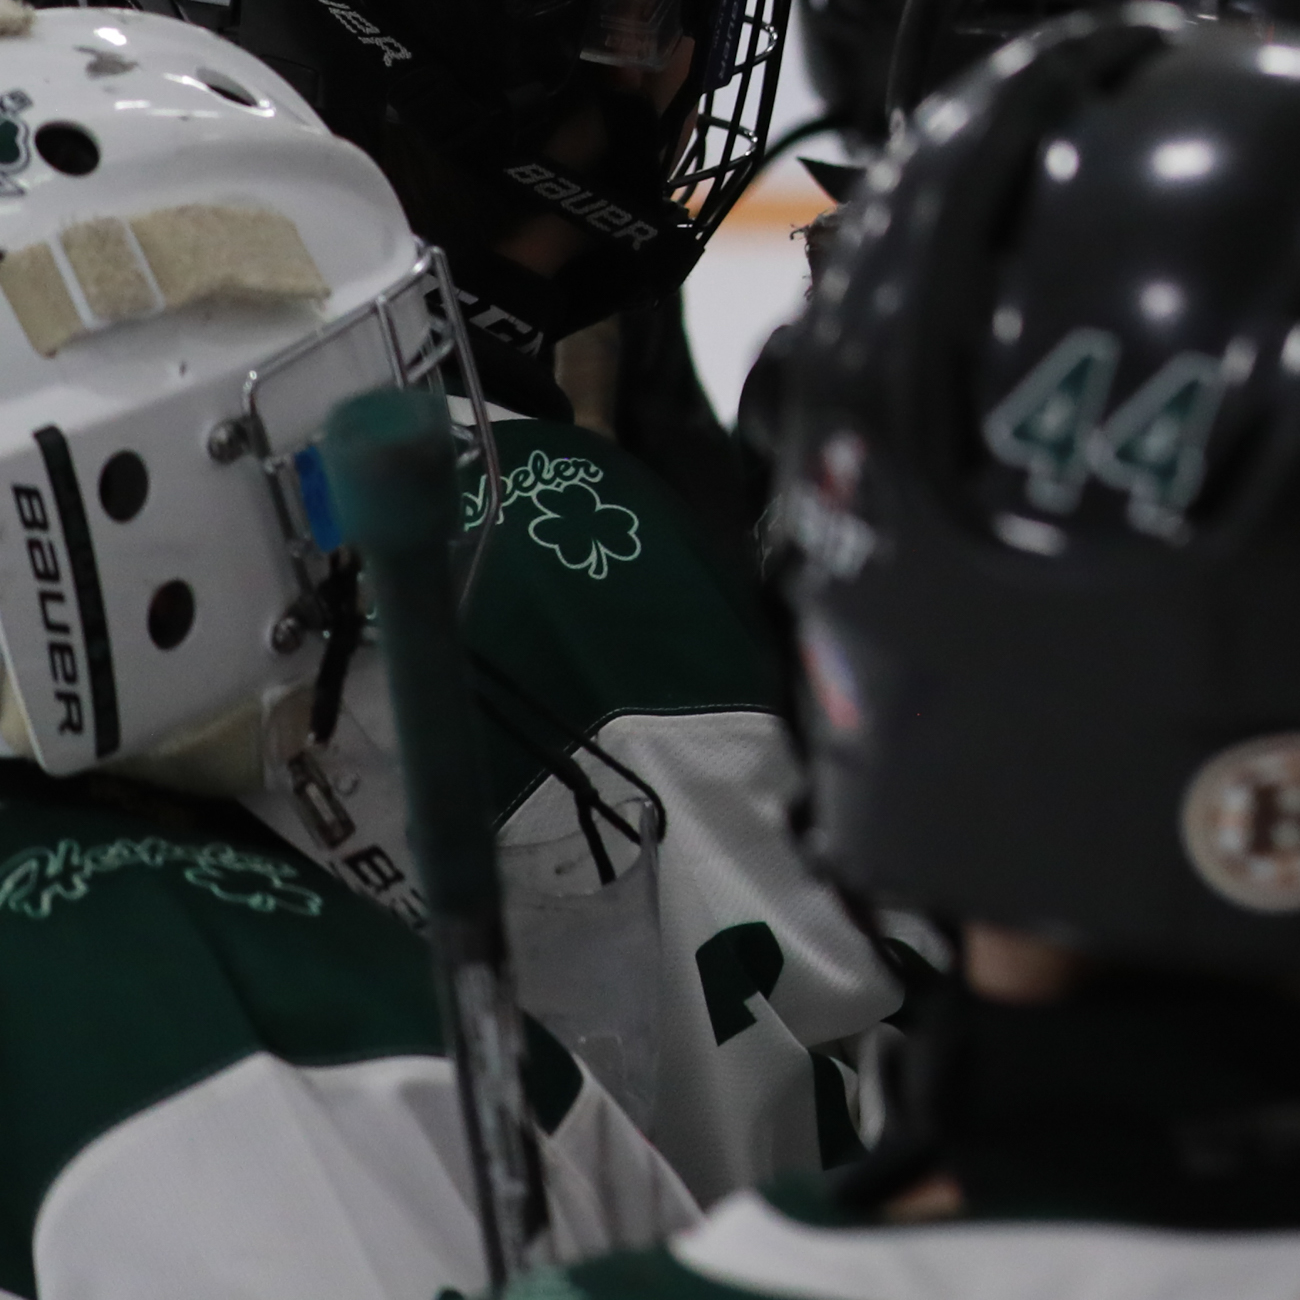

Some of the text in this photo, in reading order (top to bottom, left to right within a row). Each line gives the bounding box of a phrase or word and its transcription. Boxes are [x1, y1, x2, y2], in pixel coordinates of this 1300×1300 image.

[503, 163, 658, 250] BAUER
[982, 326, 1225, 547] 44
[12, 485, 84, 735] BAUER
